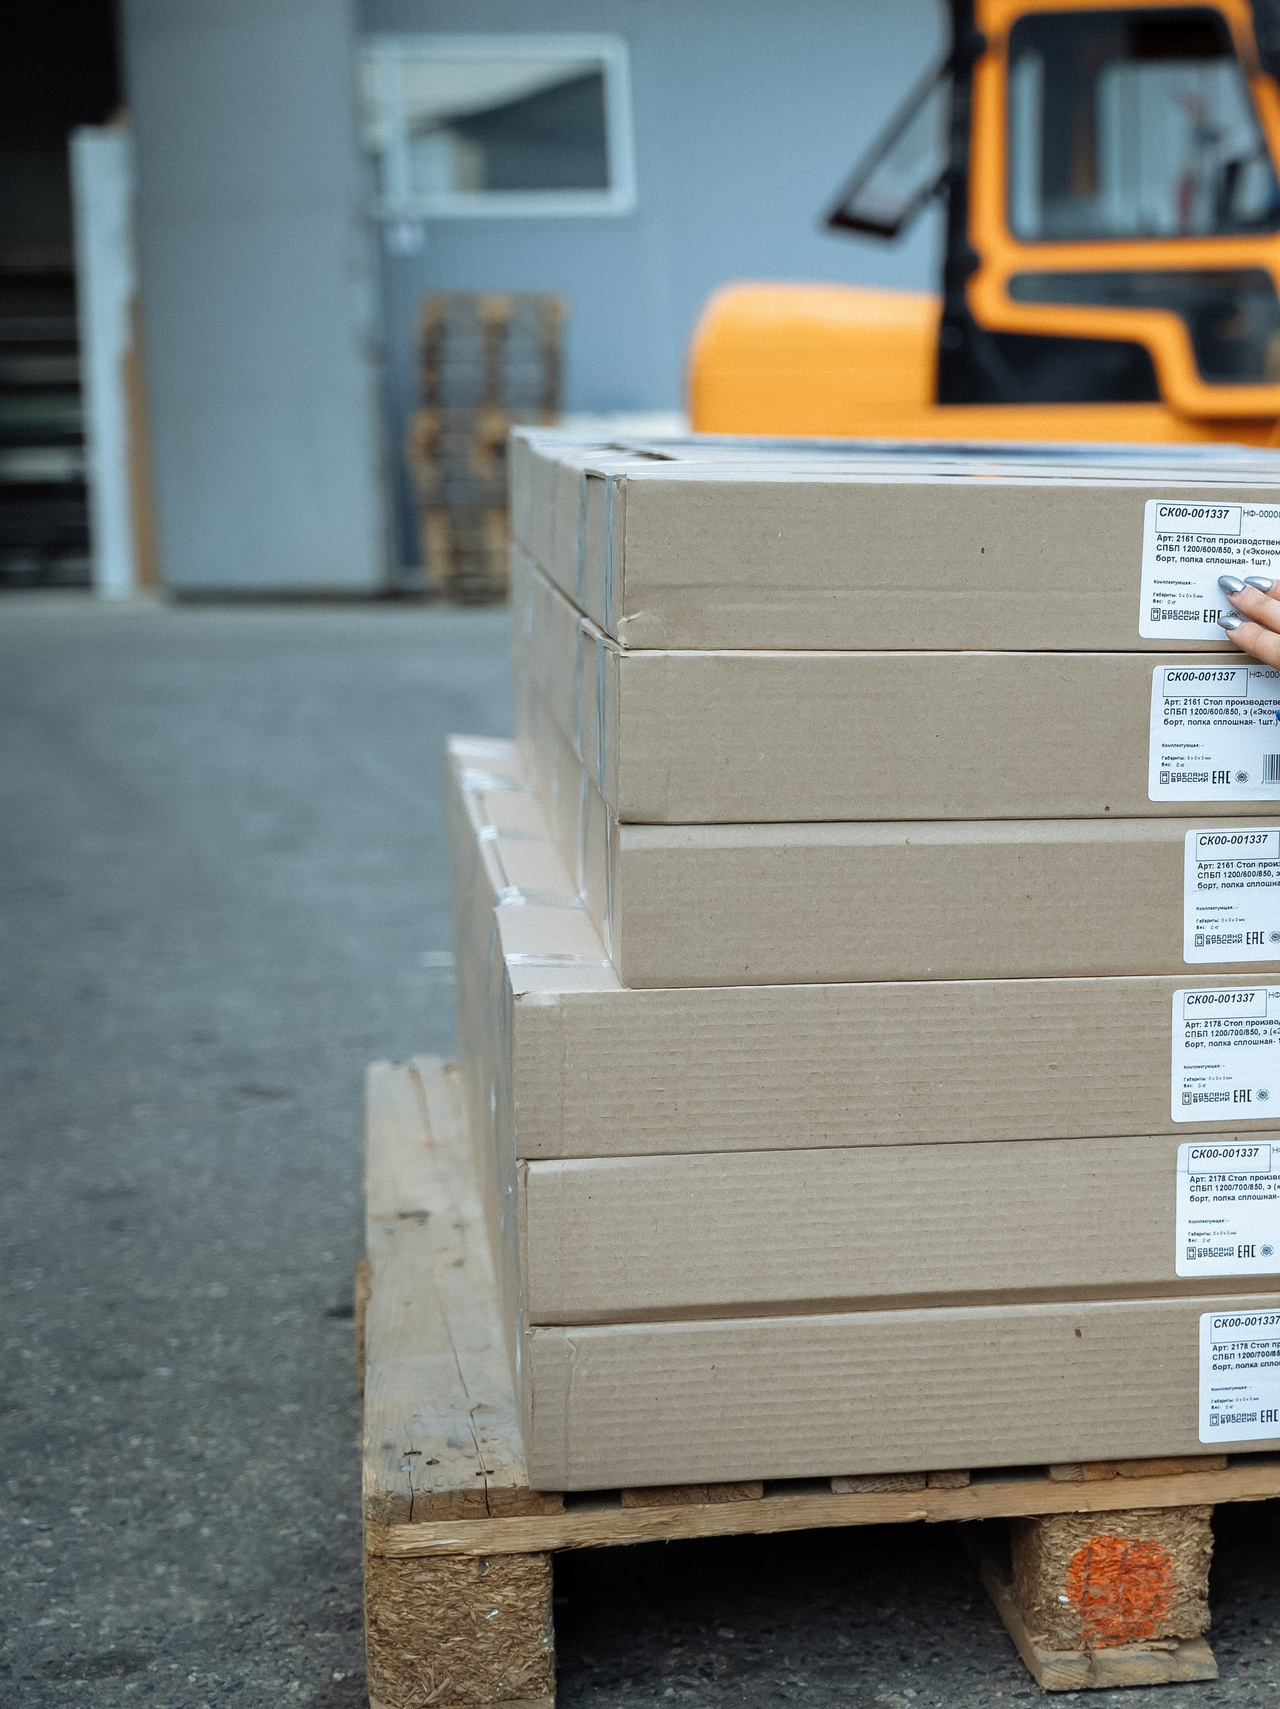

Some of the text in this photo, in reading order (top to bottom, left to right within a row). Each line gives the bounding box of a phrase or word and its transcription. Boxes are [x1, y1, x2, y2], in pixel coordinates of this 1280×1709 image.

[1157, 534, 1174, 543] Арт:
[1156, 544, 1180, 552] СПБП
[1183, 545, 1234, 555] 1200/600/850,
[1156, 554, 1177, 563] борт,
[1251, 558, 1271, 567] 1шт.)
[1164, 698, 1181, 706] Арт:
[1190, 708, 1241, 716] 1200/600/850,
[1164, 718, 1185, 726] борт,
[1258, 718, 1278, 727] 1шт.)
[1197, 862, 1214, 871] Арт:
[1224, 870, 1273, 879] 1200/600/850,
[1197, 882, 1218, 890] борт,
[1185, 1021, 1201, 1029] Арт:
[1204, 1020, 1221, 1028] 2178
[1185, 1030, 1208, 1038] СПБП
[1211, 1028, 1260, 1037] 1200/700/850,
[1185, 1040, 1206, 1049] борт,
[1189, 1176, 1206, 1184] Арт:
[1215, 1183, 1264, 1192] 1200/700/850,
[1189, 1195, 1210, 1203] борт,
[1212, 1344, 1229, 1353] Арт:
[1250, 1341, 1269, 1349] Стол
[1212, 1353, 1235, 1361] СПБП
[1212, 1363, 1233, 1372] борт,
